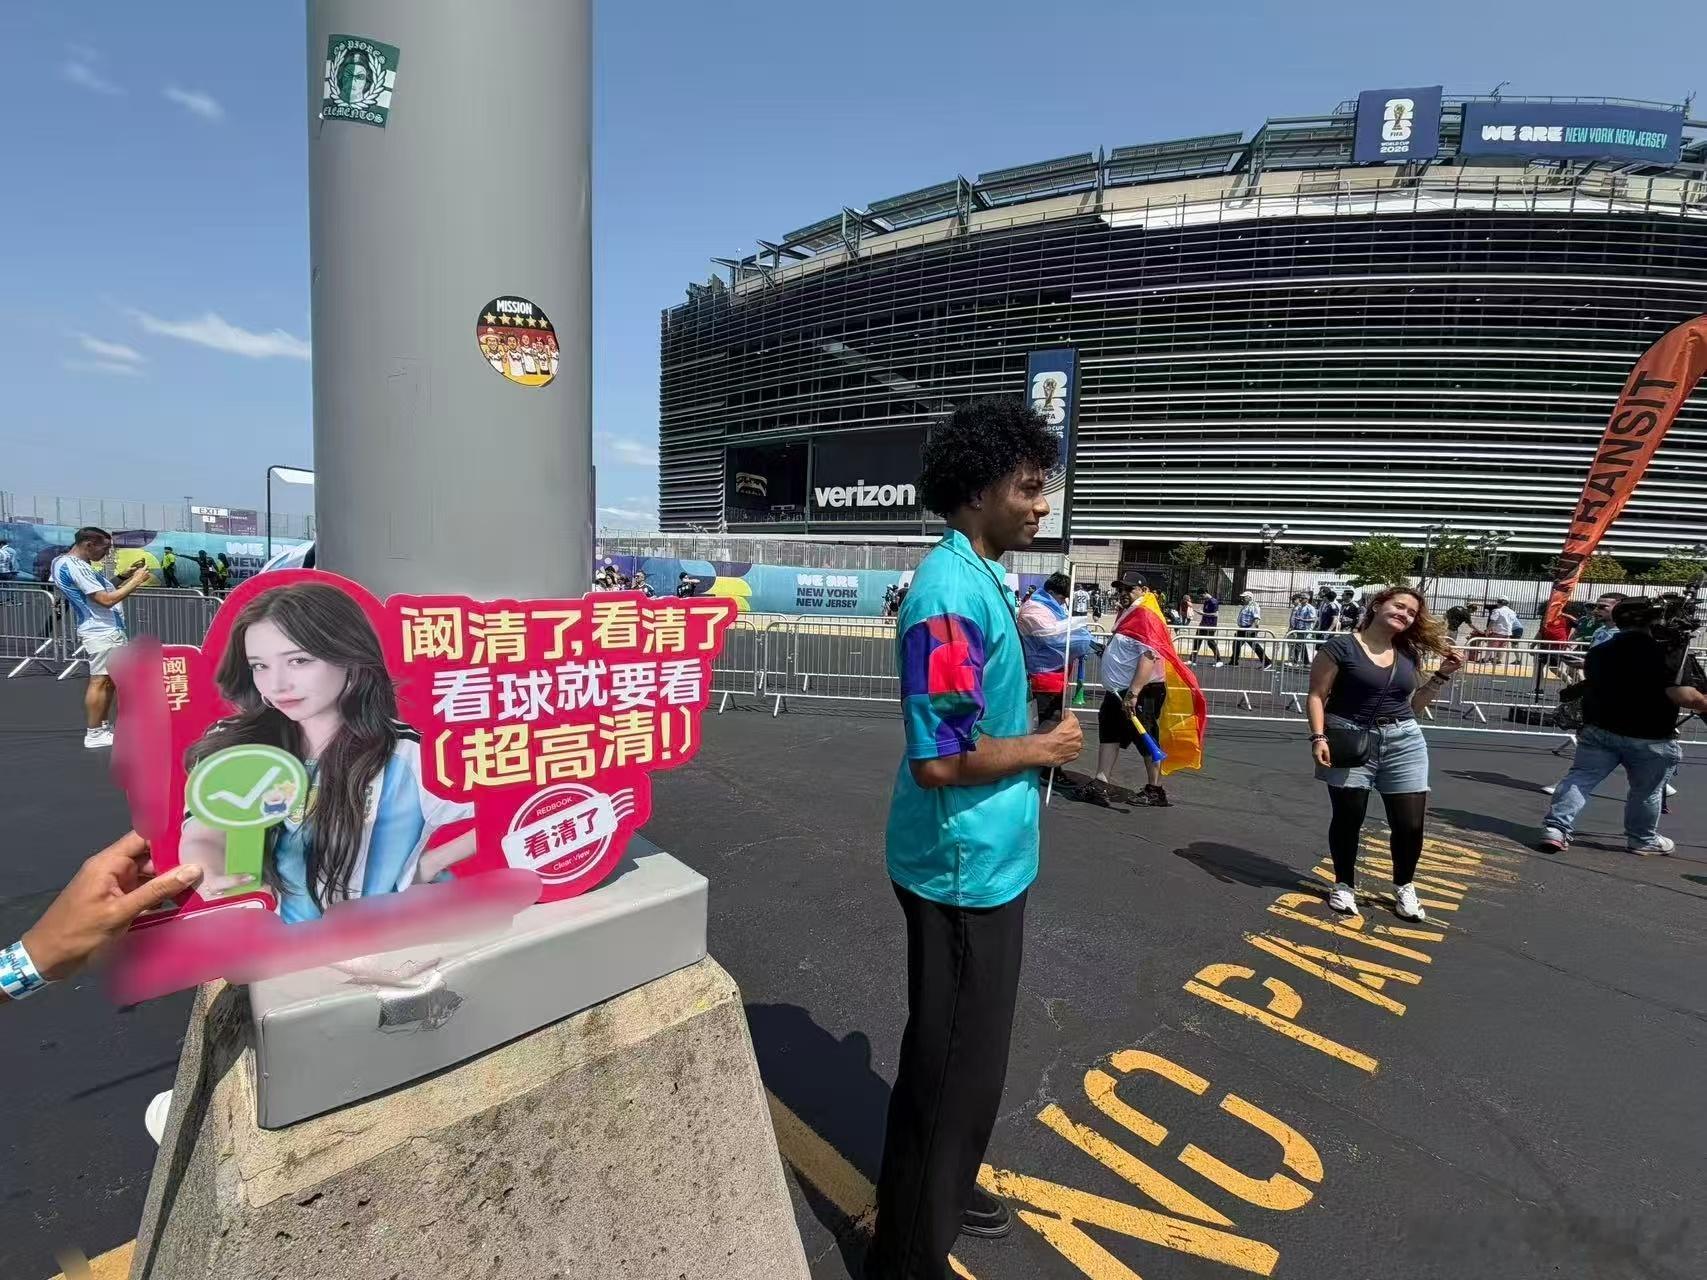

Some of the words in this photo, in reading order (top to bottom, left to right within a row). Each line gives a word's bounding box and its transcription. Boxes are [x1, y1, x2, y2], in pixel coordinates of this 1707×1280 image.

[1482, 125, 1517, 140] WE
[1565, 127, 1587, 143] NEW
[1589, 128, 1613, 143] YORK
[1615, 128, 1635, 145] NEW
[1635, 130, 1668, 148] JERSEY
[497, 299, 533, 315] MISSION
[814, 479, 916, 508] verizon
[796, 598, 824, 607] NEW
[825, 599, 857, 608] JERSEY
[797, 588, 824, 597] NEW
[826, 589, 858, 598] YORK
[163, 656, 190, 711] 阚清子
[432, 658, 703, 722] 看球就要看
[536, 796, 573, 816] REDBOOK
[523, 807, 599, 860] 看清了
